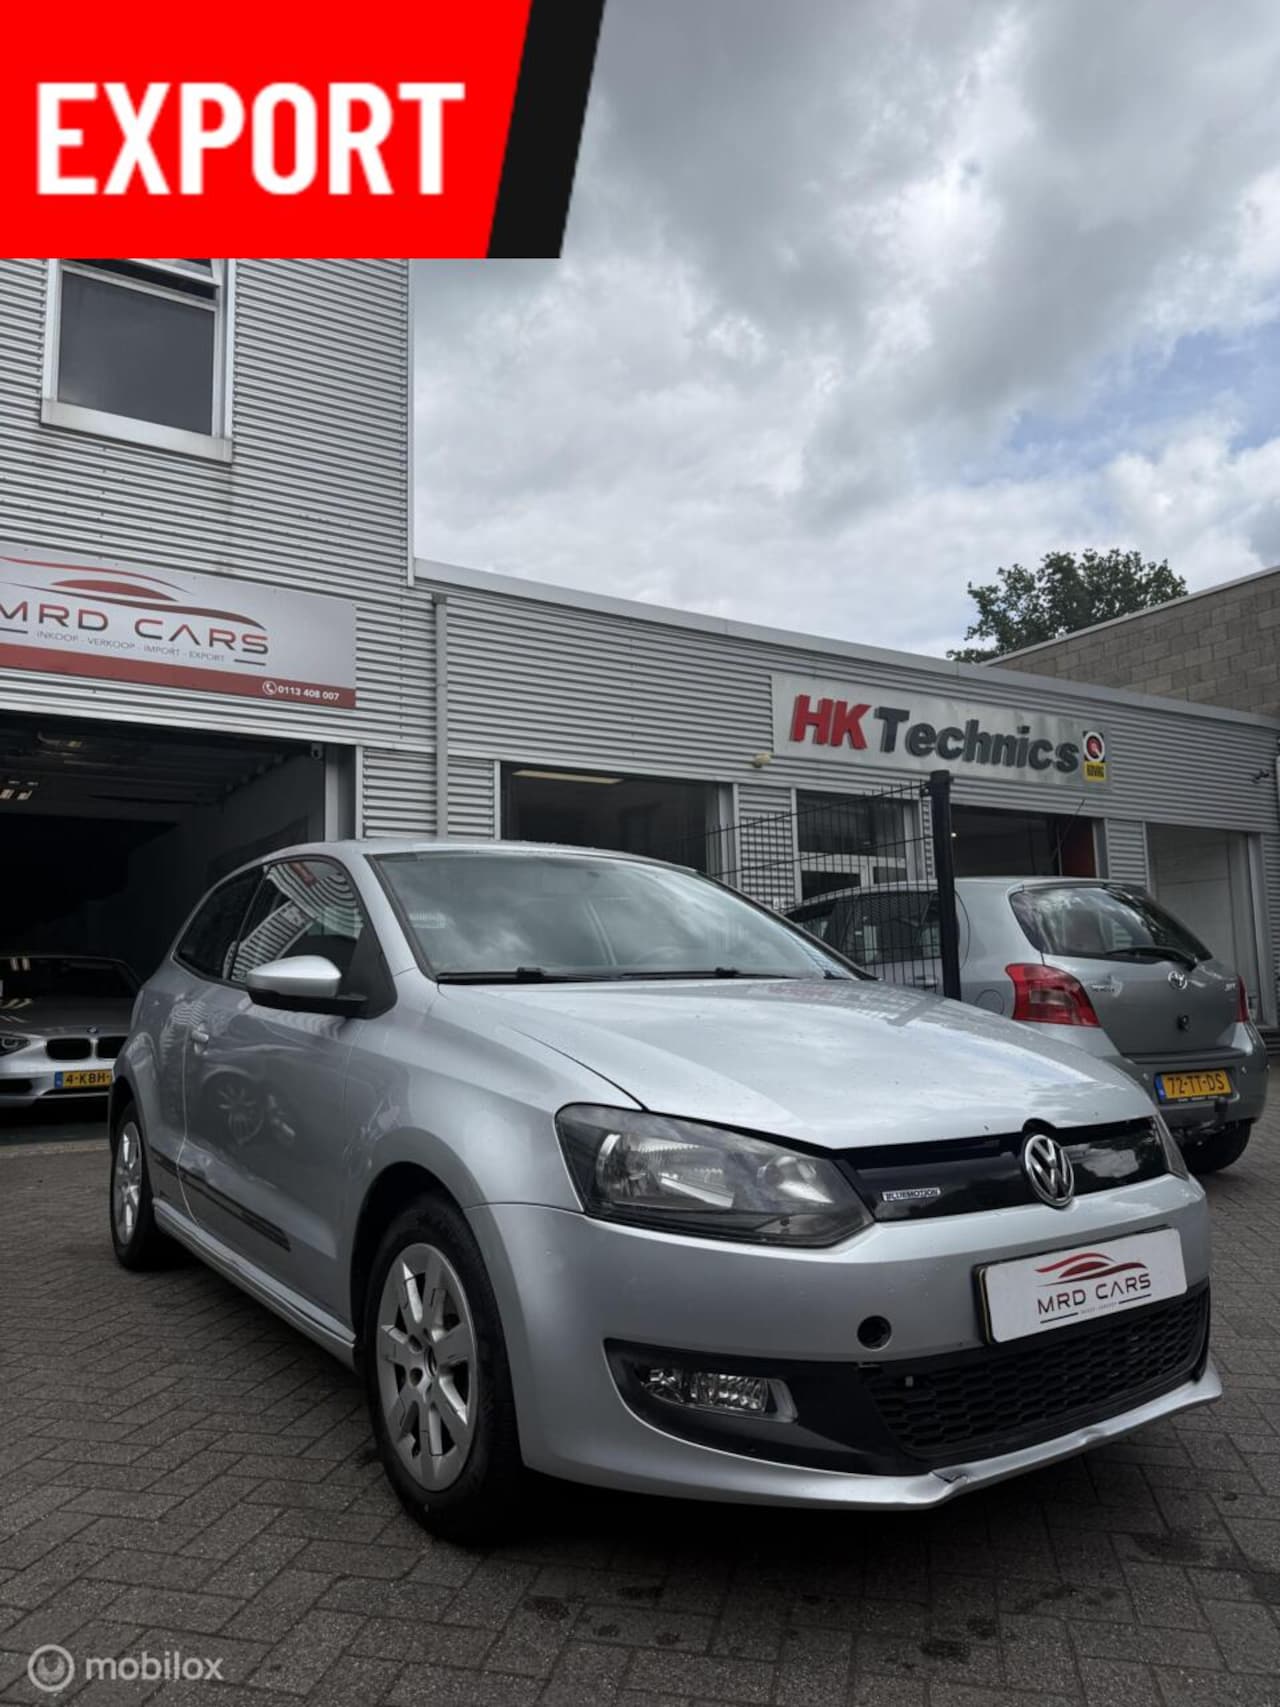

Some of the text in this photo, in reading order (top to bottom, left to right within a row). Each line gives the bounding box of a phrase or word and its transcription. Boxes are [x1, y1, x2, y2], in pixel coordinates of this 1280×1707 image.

[134, 618, 269, 655] CARS
[278, 685, 301, 697] 0113
[322, 691, 340, 701] 007
[1167, 1073, 1225, 1095] 72-TT-DS
[1037, 1289, 1087, 1315] MRD
[1095, 1273, 1152, 1300] CARS
